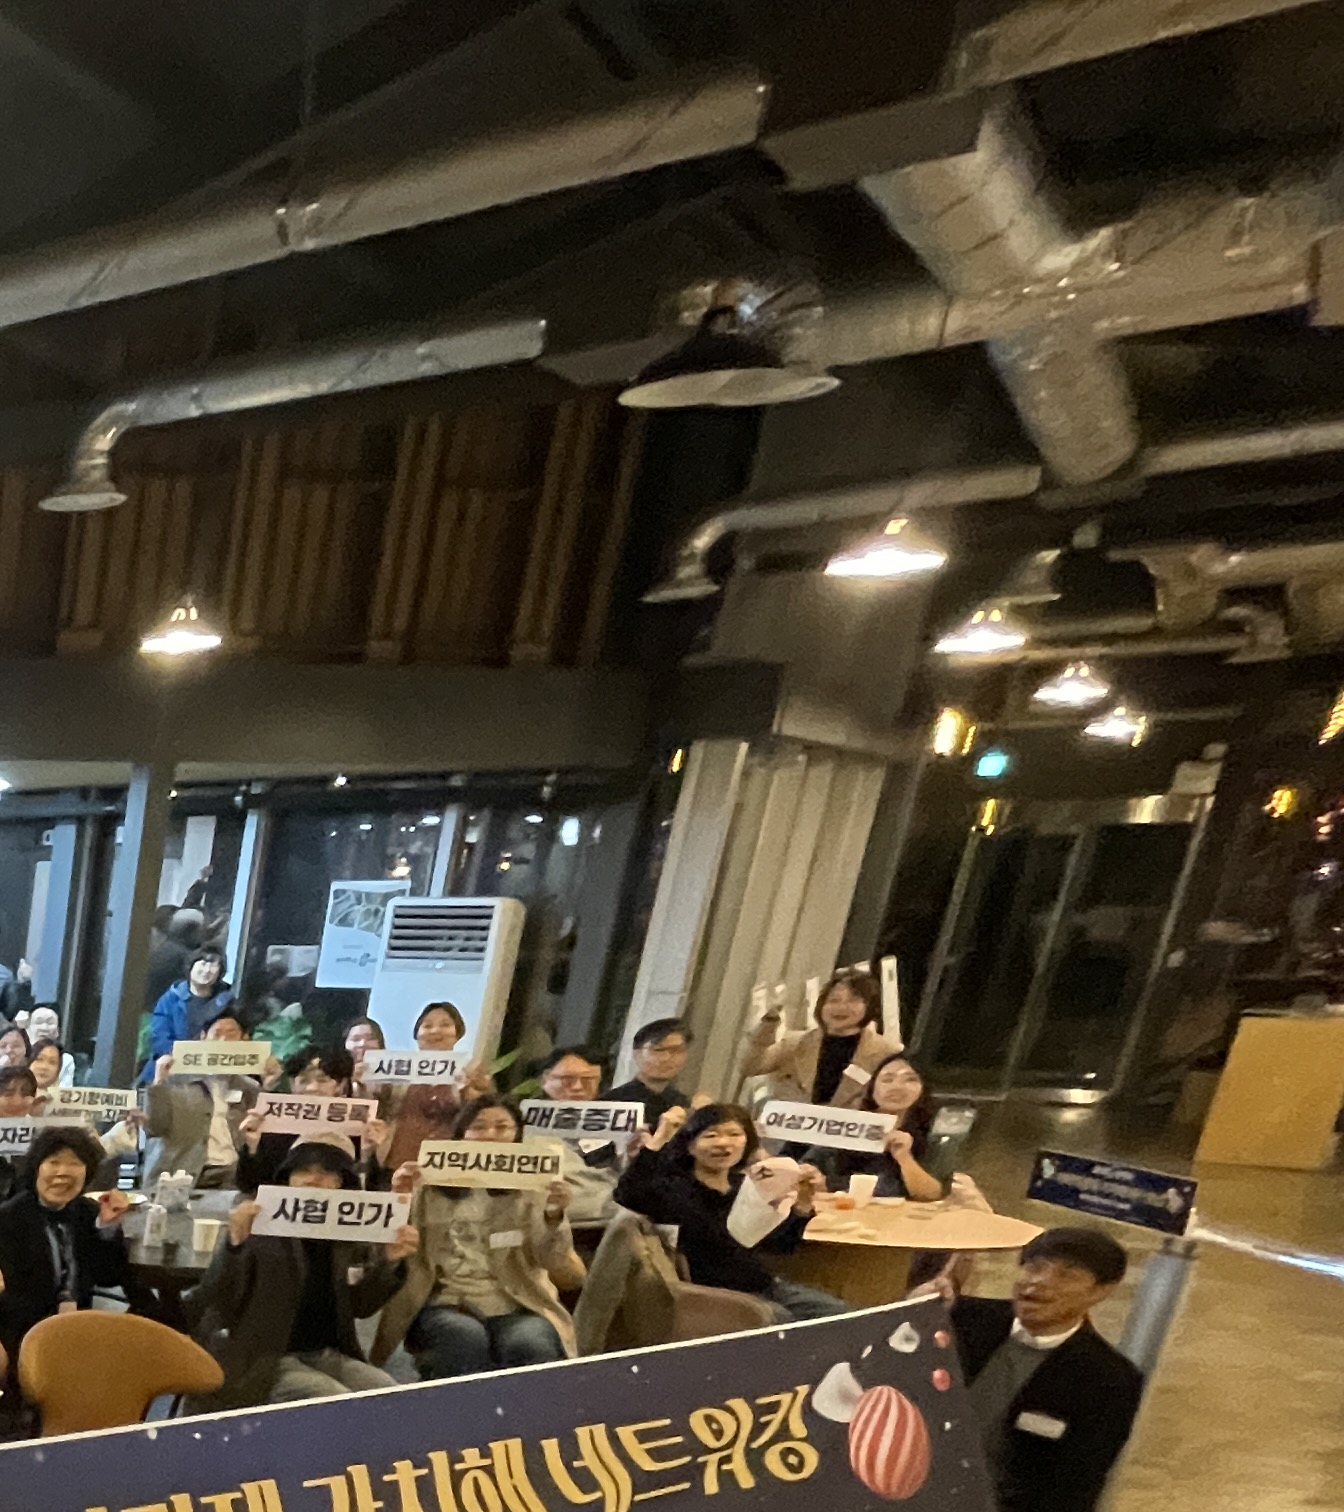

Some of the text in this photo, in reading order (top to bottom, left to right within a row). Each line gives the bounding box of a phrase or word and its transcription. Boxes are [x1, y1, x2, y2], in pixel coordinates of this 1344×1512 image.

[182, 1053, 202, 1066] SE
[417, 1058, 457, 1077] 인가
[264, 1101, 322, 1121] 저작권
[524, 1101, 639, 1133] 매출증대
[765, 1111, 885, 1141] 여성기업인증
[424, 1150, 560, 1176] 지역사회연대
[272, 1197, 395, 1229] 사협 인가
